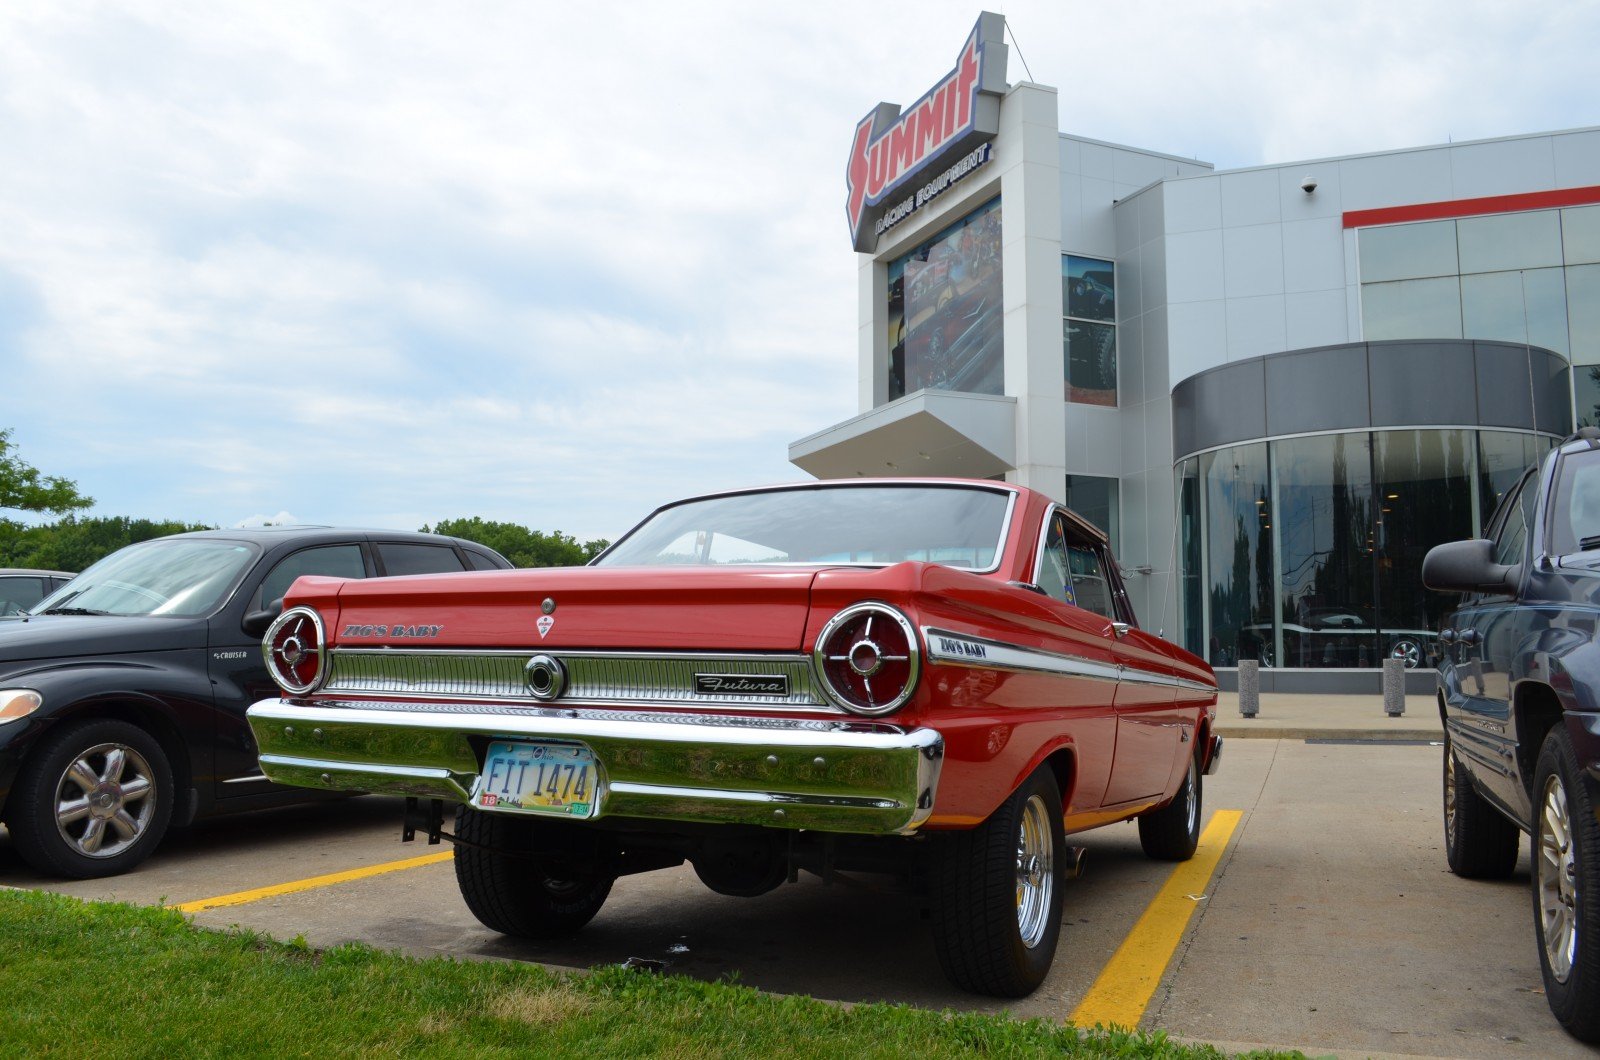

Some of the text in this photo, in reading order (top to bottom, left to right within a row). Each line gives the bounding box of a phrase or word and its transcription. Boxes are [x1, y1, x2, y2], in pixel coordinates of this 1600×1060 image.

[875, 143, 991, 236] RACING EQUIPMENT
[341, 624, 444, 638] ZIG'S BABY
[220, 651, 248, 659] CRUISER
[938, 637, 987, 659] ZIG'S BABY
[698, 676, 785, 692] Futura
[487, 757, 588, 801] FIT 1474
[483, 795, 496, 806] 18
